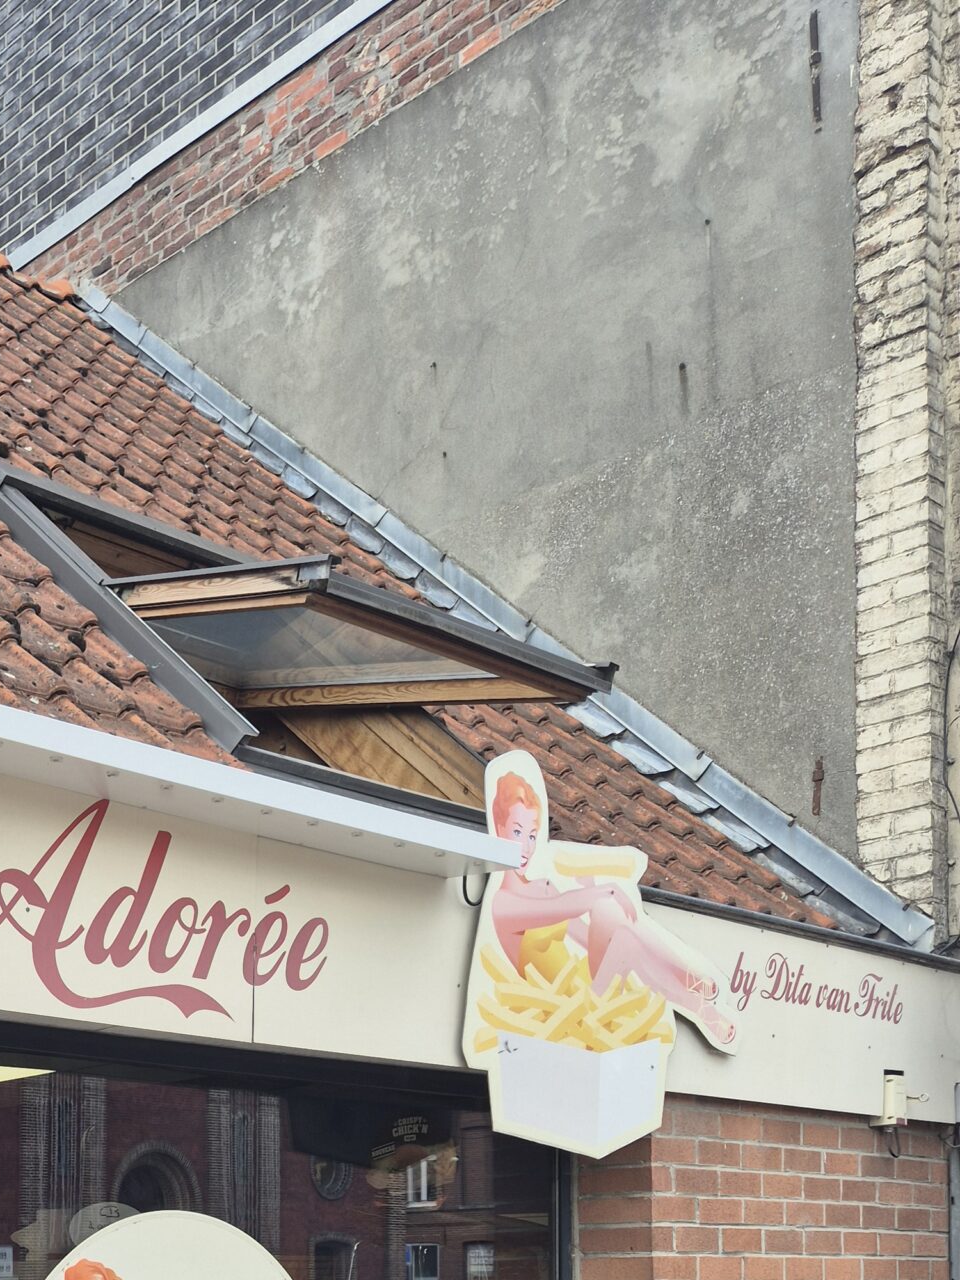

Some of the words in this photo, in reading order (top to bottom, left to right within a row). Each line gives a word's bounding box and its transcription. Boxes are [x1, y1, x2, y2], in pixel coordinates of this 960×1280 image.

[729, 951, 758, 1011] by
[760, 952, 812, 1006] Dita
[815, 984, 852, 1014] van
[853, 973, 904, 1025] Frite
[392, 1123, 429, 1138] CHICK'N
